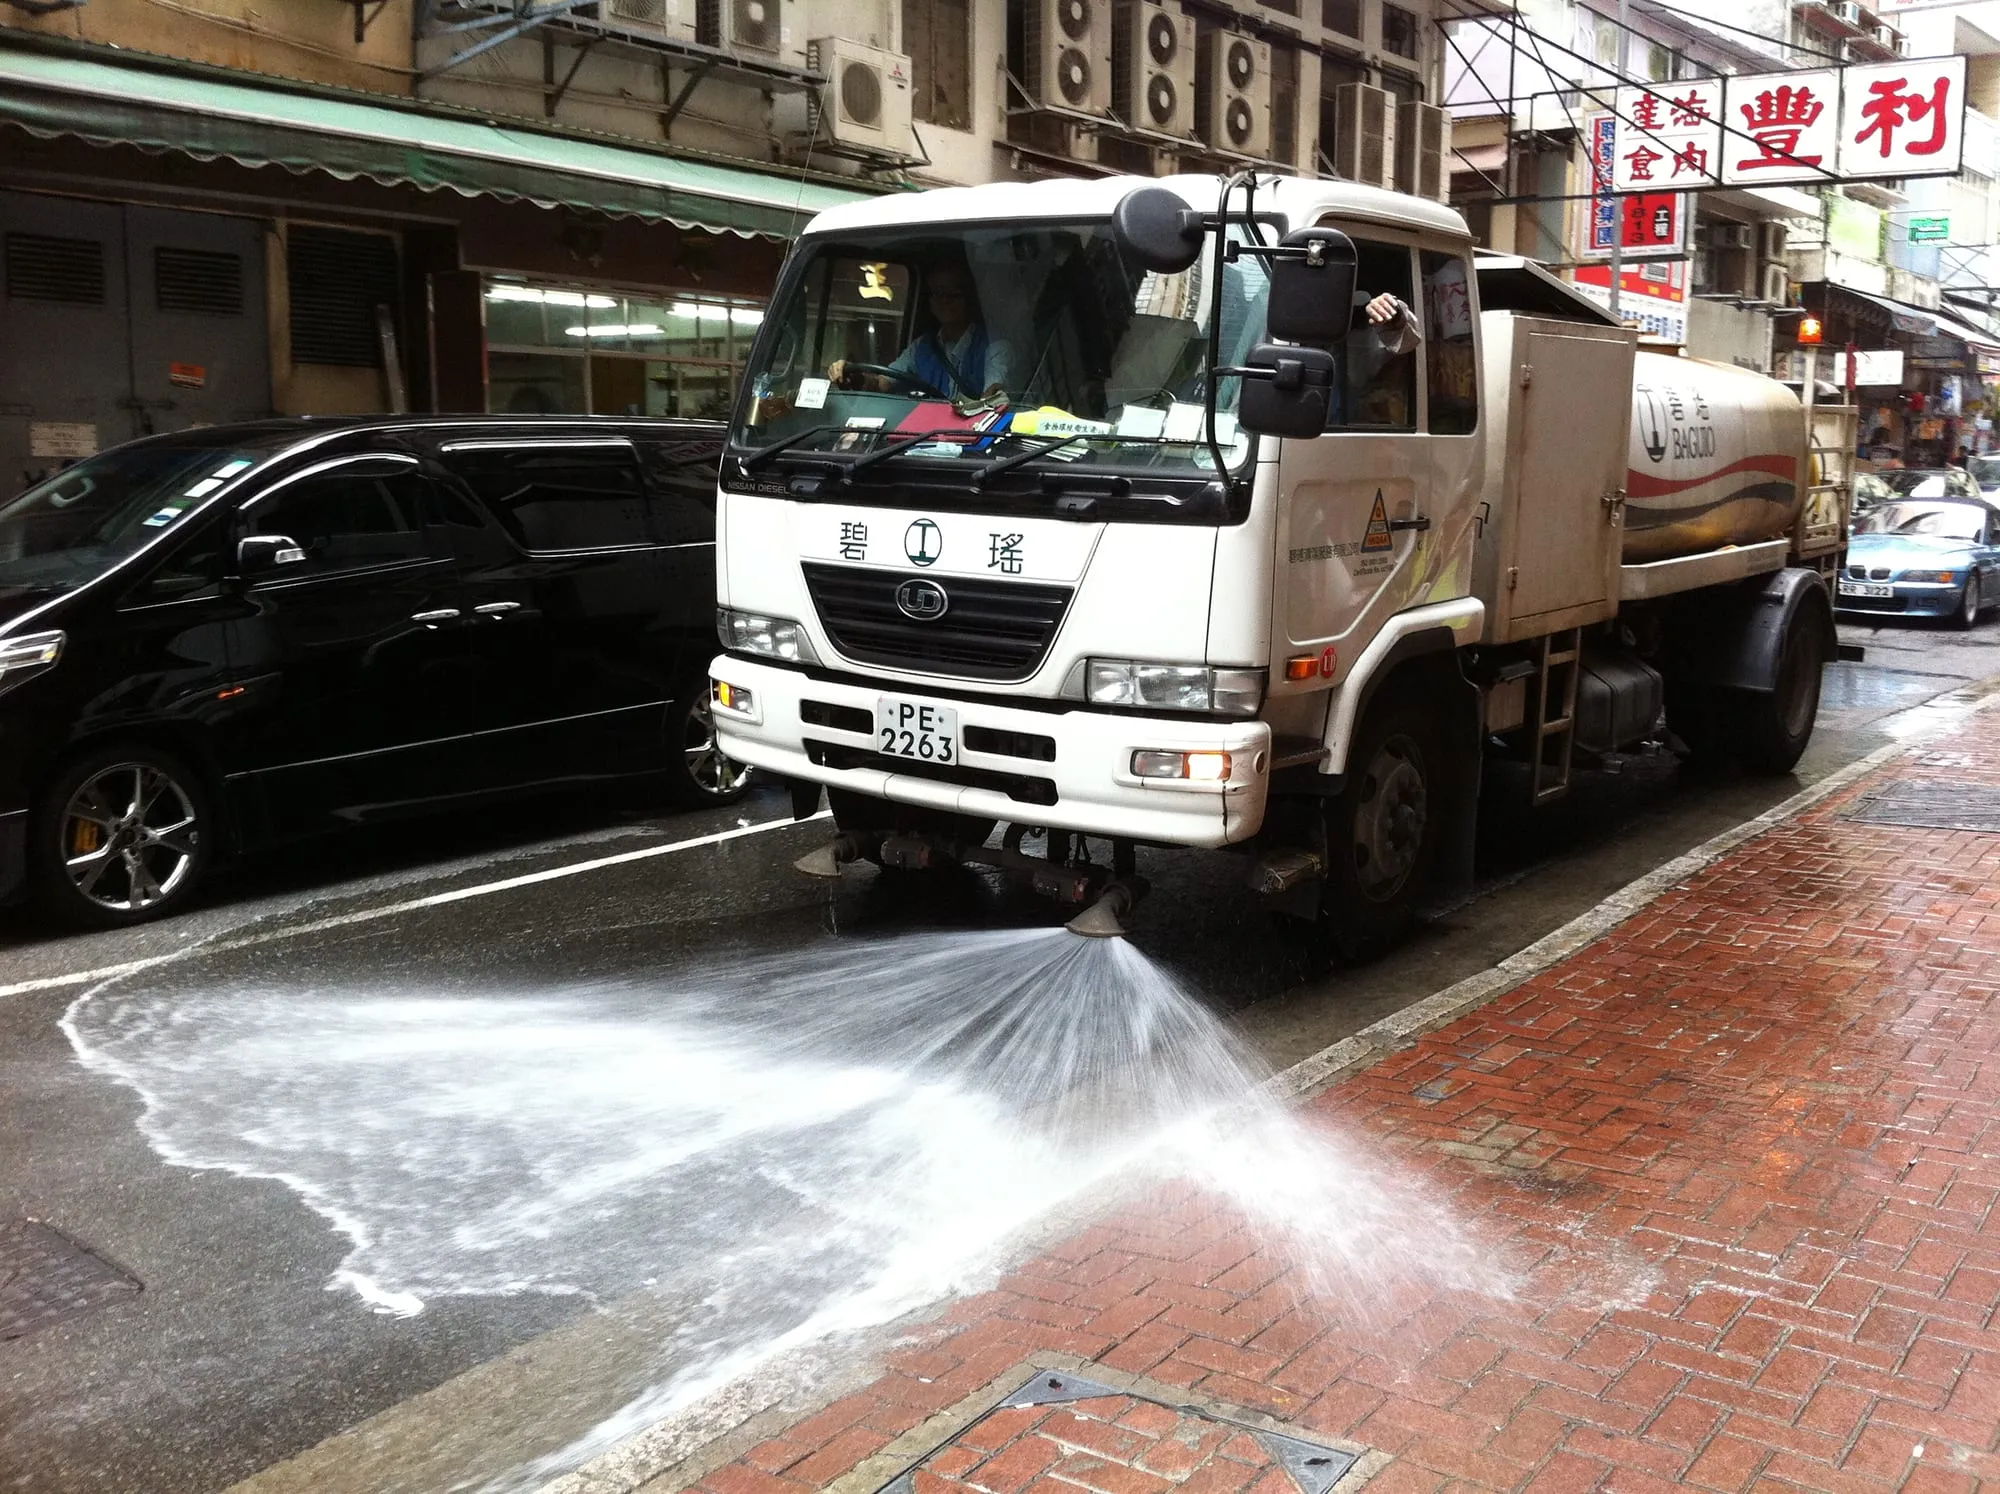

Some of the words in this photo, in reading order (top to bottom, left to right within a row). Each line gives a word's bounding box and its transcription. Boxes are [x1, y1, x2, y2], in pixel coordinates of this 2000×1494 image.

[728, 481, 756, 491] NISSAN
[758, 484, 791, 495] DIESEL
[901, 587, 942, 613] UD
[900, 703, 935, 733] PE
[881, 727, 953, 762] 2263
